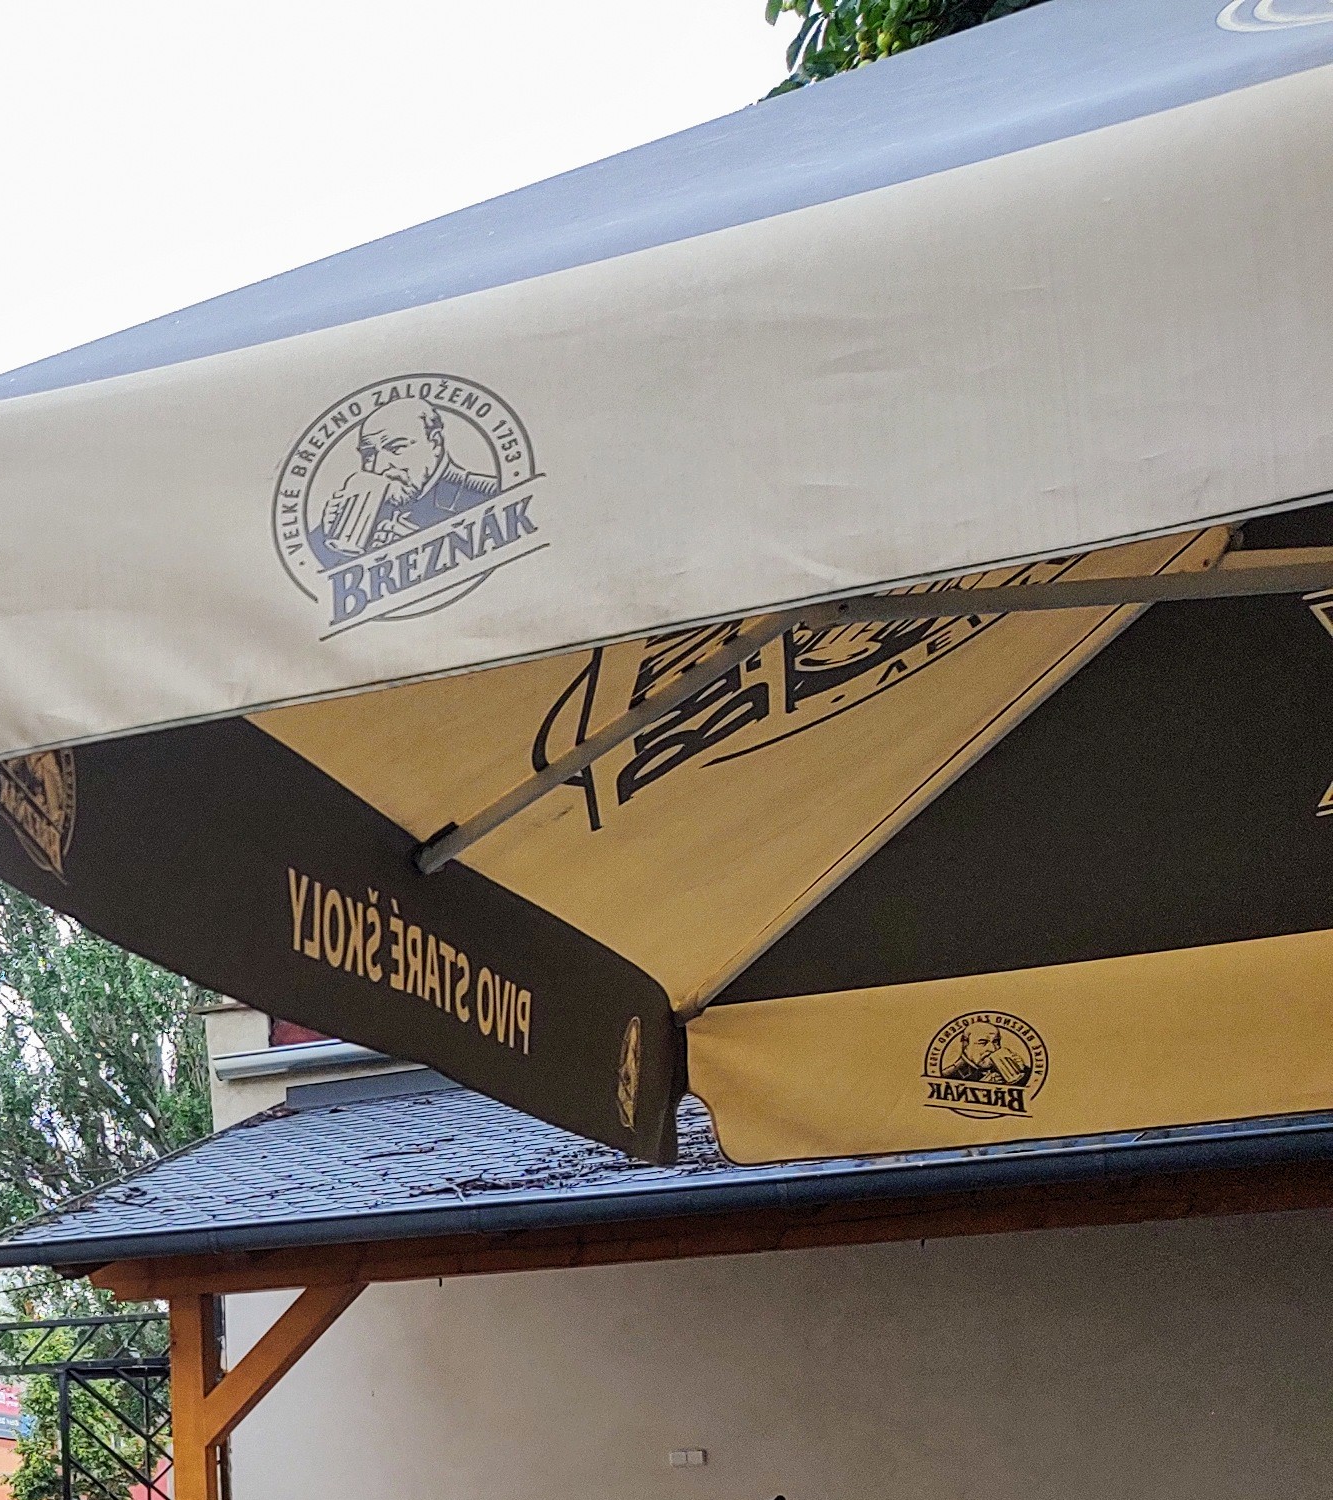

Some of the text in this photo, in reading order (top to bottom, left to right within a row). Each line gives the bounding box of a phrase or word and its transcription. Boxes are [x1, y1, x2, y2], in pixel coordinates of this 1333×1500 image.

[281, 380, 523, 556] VELKÉ BŘEZNO ZALOŽENO 1753
[327, 494, 538, 626] BŘEZŇÁK
